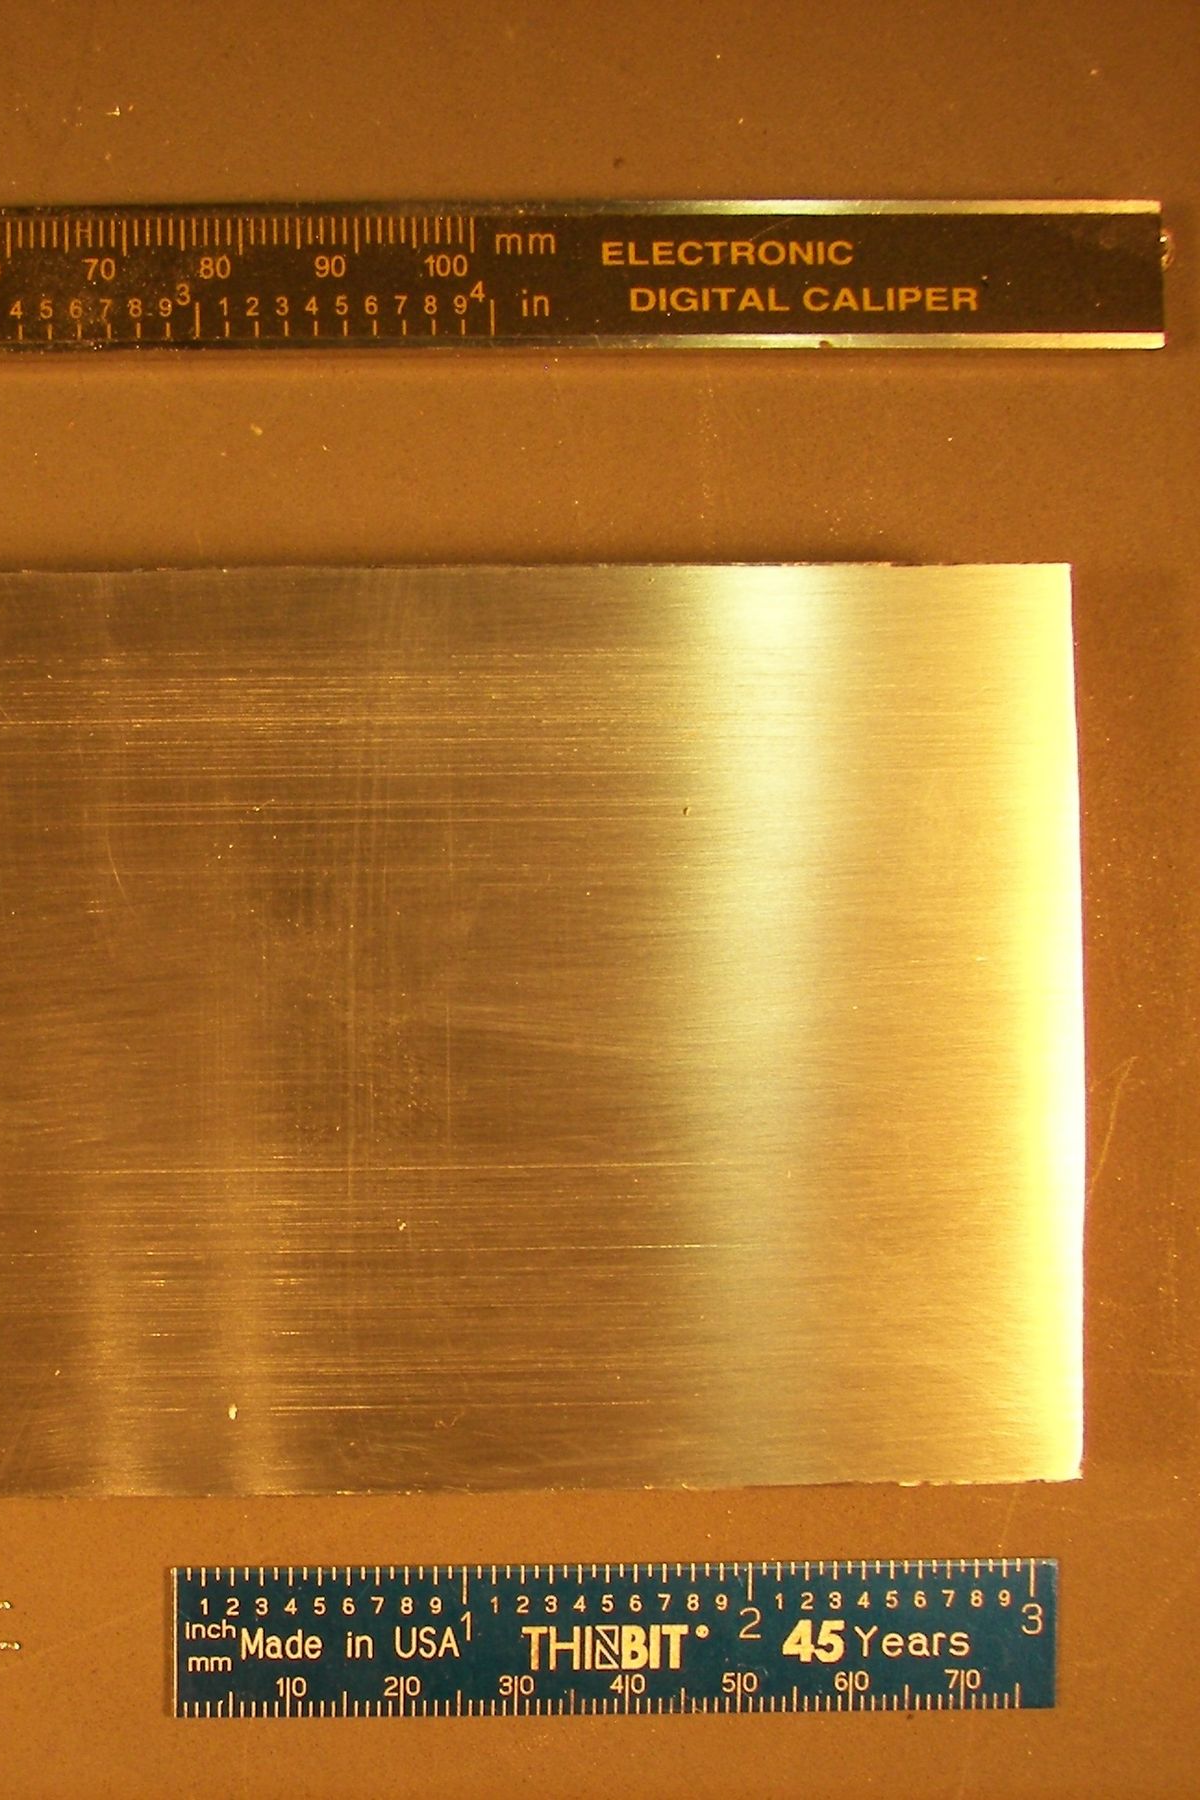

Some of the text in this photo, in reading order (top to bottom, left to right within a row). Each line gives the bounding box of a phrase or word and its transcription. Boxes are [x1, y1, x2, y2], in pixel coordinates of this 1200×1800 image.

[496, 231, 555, 254] mm
[601, 241, 853, 266] ELECTRONIC
[85, 259, 116, 280] 70
[200, 257, 230, 279] 80
[315, 256, 345, 277] 90
[425, 255, 467, 277] 100
[10, 300, 22, 319] 4
[40, 300, 52, 319] 5
[70, 299, 82, 318] 6
[99, 299, 111, 317] 7
[129, 298, 141, 317] 8
[159, 298, 171, 316] 9
[177, 284, 191, 305] 3
[246, 297, 258, 316] 2
[276, 297, 288, 316] 3
[305, 297, 317, 315] 4
[336, 297, 348, 315] 5
[365, 296, 377, 315] 6
[394, 296, 407, 315] 7
[424, 296, 436, 314] 8
[454, 296, 466, 314] 9
[470, 282, 485, 302] 4
[522, 290, 549, 316] in
[630, 288, 978, 312] DIGITAL CALIPER
[226, 1599, 240, 1616] 2
[255, 1599, 268, 1615] 3
[284, 1599, 297, 1615] 4
[313, 1598, 327, 1615] 5
[342, 1598, 355, 1615] 6
[371, 1598, 384, 1615] 7
[400, 1598, 414, 1614] 8
[429, 1598, 442, 1614] 9
[516, 1595, 529, 1613] 2
[544, 1595, 558, 1613] 3
[573, 1595, 586, 1613] 4
[601, 1595, 614, 1613] 5
[629, 1593, 642, 1611] 6
[657, 1593, 671, 1611] 7
[686, 1593, 700, 1611] 8
[714, 1593, 728, 1611] 9
[739, 1607, 761, 1639] 2
[800, 1592, 814, 1610] 2
[828, 1592, 842, 1610] 3
[857, 1591, 870, 1609] 4
[885, 1591, 898, 1609] 5
[913, 1590, 927, 1608] 6
[942, 1590, 955, 1608] 7
[970, 1590, 983, 1608] 8
[997, 1589, 1011, 1607] 9
[1021, 1602, 1043, 1635] 3
[185, 1618, 236, 1640] inch
[782, 1619, 970, 1663] 45 Years
[241, 1626, 460, 1661] Made in USA
[187, 1655, 232, 1672] mm
